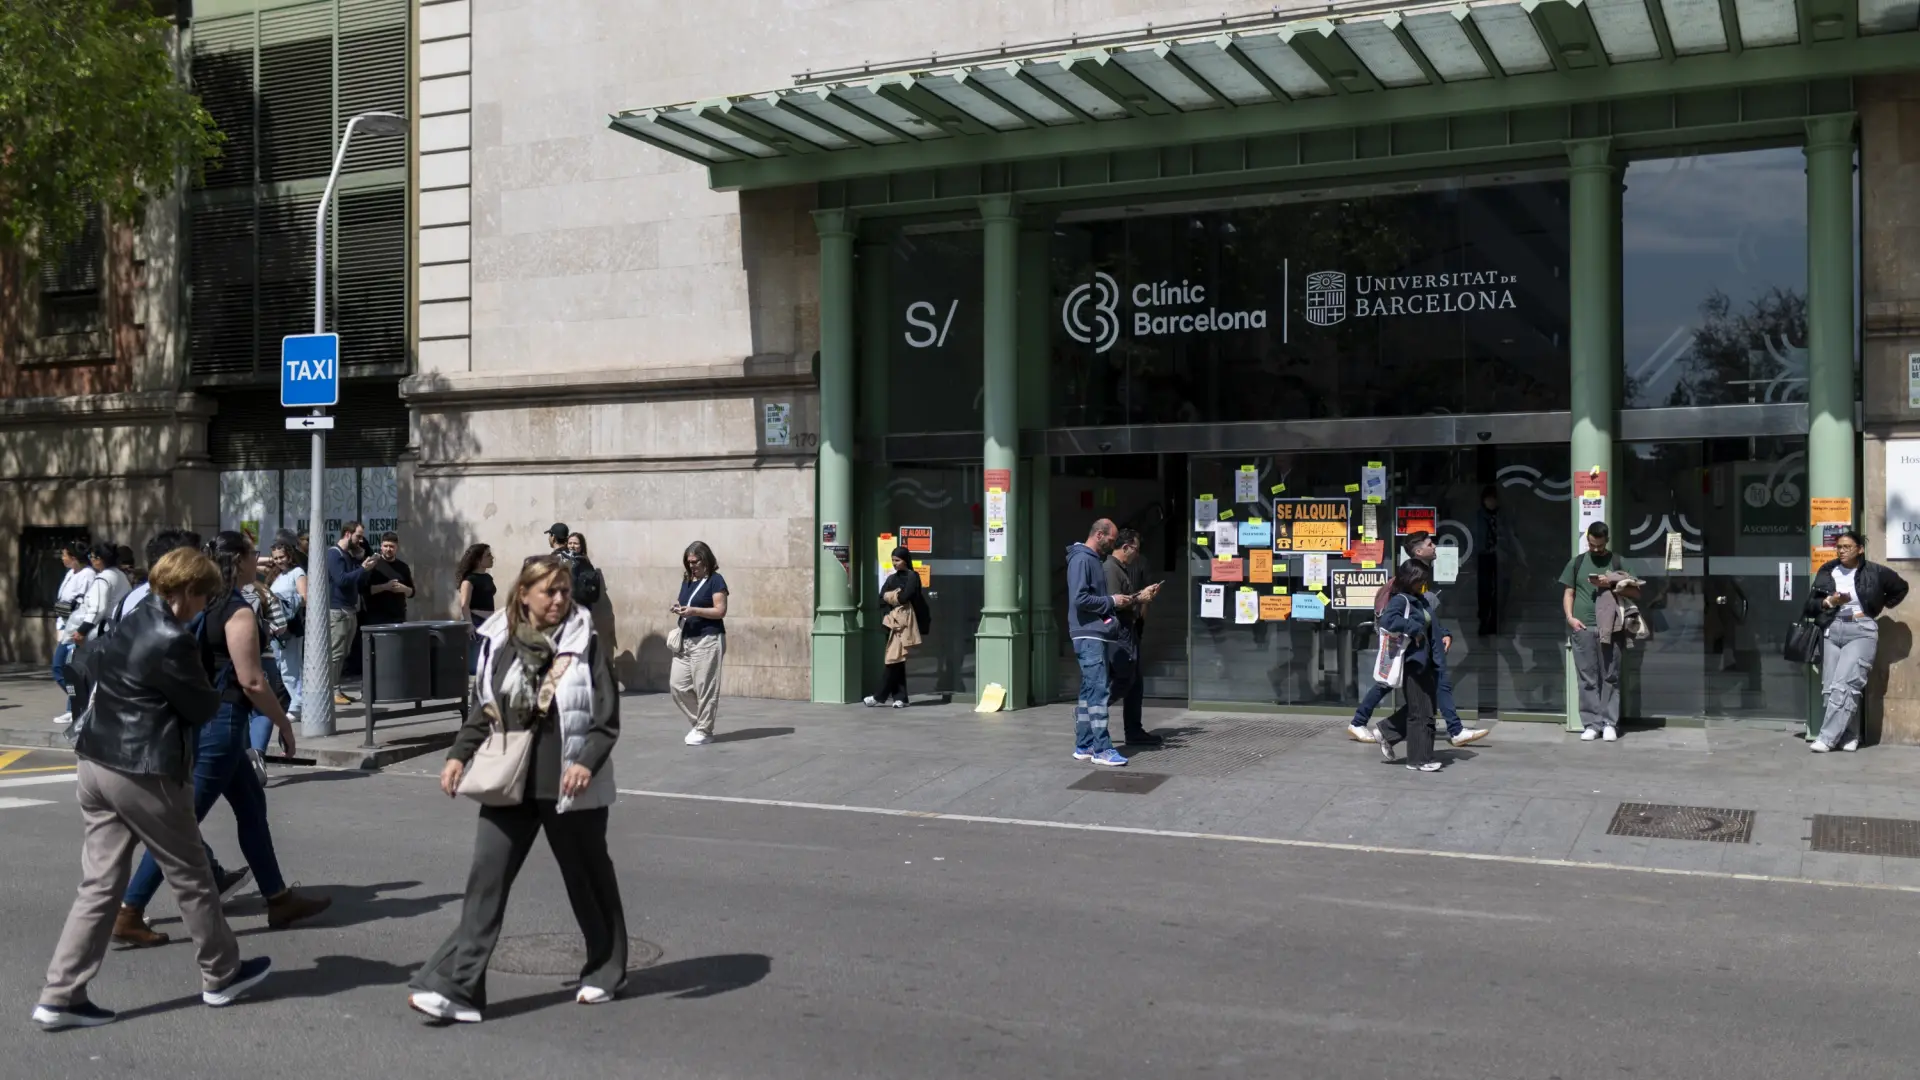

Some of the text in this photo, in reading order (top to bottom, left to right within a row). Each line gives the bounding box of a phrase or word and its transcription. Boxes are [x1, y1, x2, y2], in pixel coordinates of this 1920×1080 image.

[1132, 279, 1206, 307] Clínic
[1355, 270, 1498, 295] UNIVERSITAT
[1355, 289, 1517, 317] BARCELONA
[904, 299, 959, 348] S/
[1134, 307, 1267, 336] Barcelona
[286, 359, 333, 381] TAXI
[793, 433, 818, 447] 170
[1277, 503, 1347, 520] SE ALQUILA
[909, 529, 930, 537] ALQUILA
[1743, 524, 1789, 533] Ascensor
[1334, 573, 1386, 586] SE ALQUILA
